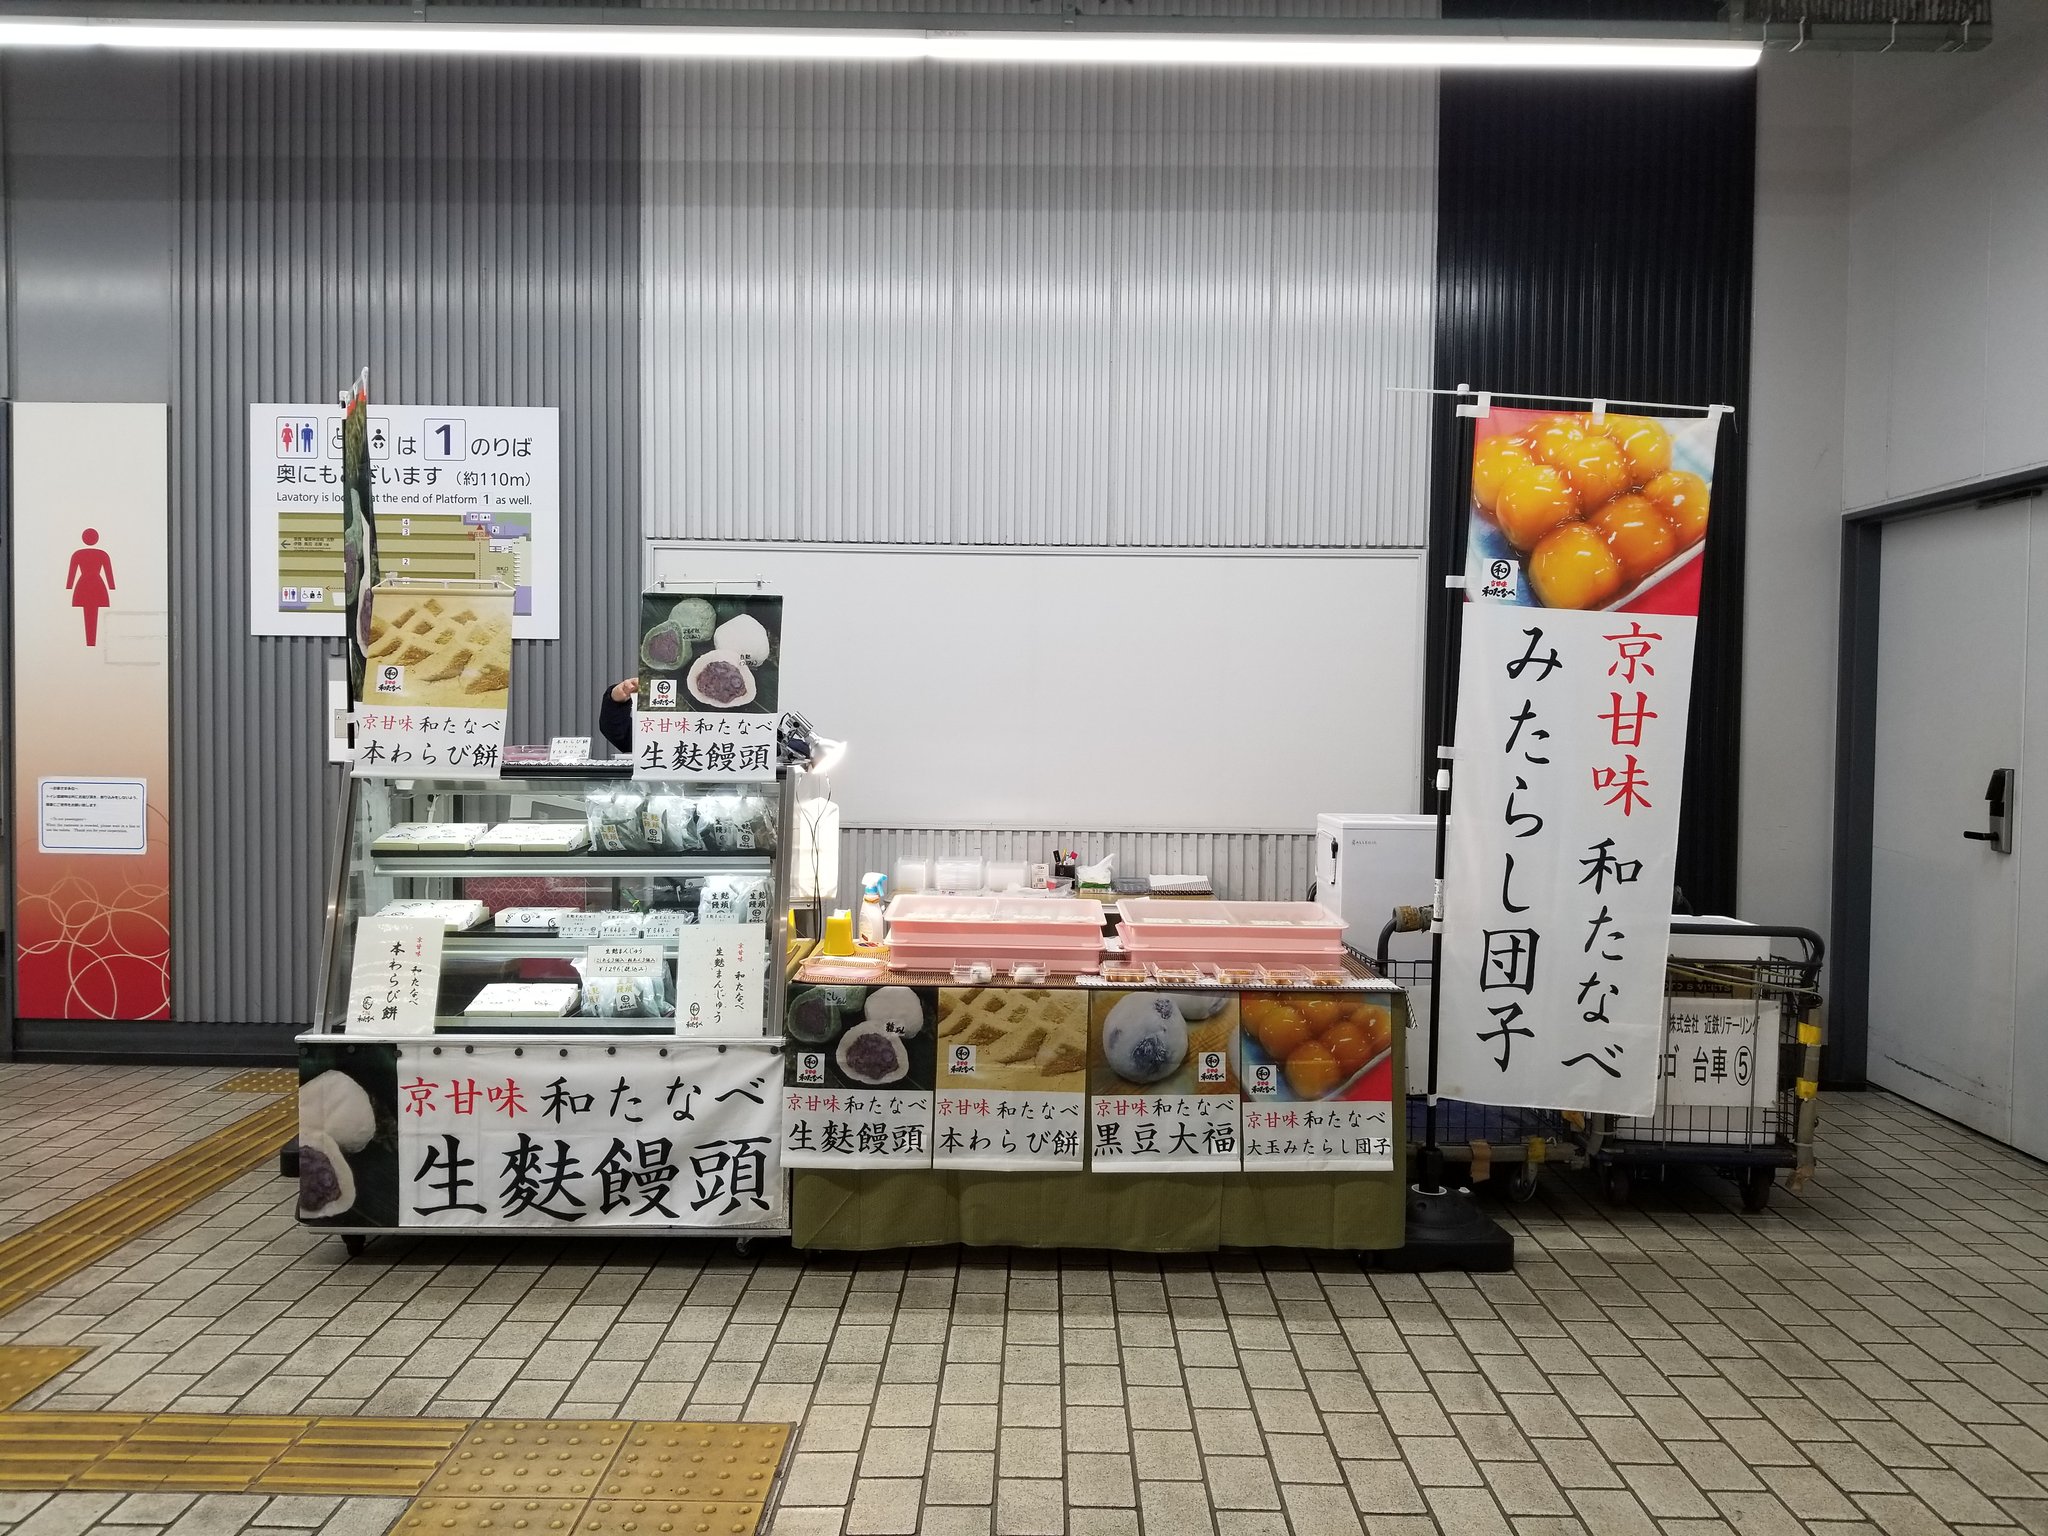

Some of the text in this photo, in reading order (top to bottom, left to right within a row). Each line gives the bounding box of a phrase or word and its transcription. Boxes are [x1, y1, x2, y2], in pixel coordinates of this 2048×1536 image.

[398, 424, 533, 458] は 1 のりば
[276, 464, 443, 485] 奥にもざいます
[276, 492, 319, 504] Lavatory
[321, 492, 329, 502] is
[383, 493, 398, 503] the
[401, 493, 420, 504] end
[422, 493, 433, 504] of
[435, 494, 478, 505] Platform
[482, 494, 489, 504] 1
[495, 496, 507, 505] as
[509, 495, 532, 505] well.
[1481, 586, 1516, 598] 和たなべ
[362, 714, 501, 734] 京甘味 和たなべ
[640, 717, 773, 735] 京甘味 和たなべ
[360, 739, 499, 768] 本わらび餅
[640, 740, 771, 772] 生麩饅頭
[1475, 625, 1564, 1074] みたらし団子
[1560, 621, 1664, 1081] 京甘味 和たなべ
[381, 941, 406, 1021] 本わらび餅
[408, 965, 423, 1006] 和たなべ
[713, 946, 725, 1023] 生麩まんじゅう
[734, 971, 746, 1010] 和たなべ
[1669, 1014, 1700, 1034] 株式会社
[798, 1073, 823, 1082] 和たなべ
[950, 1065, 975, 1074] 和たなべ
[1200, 1072, 1225, 1082] 和たなべ
[400, 1075, 766, 1125] 京甘味 和たなべ
[1251, 1086, 1276, 1094] 和たなべ
[786, 1093, 928, 1115] 京甘味 和たなべ
[937, 1098, 1080, 1121] 京甘味 和たなべ
[1095, 1098, 1235, 1118] 京甘味 和たなべ
[1246, 1110, 1387, 1129] 京甘味 和たなべ
[788, 1119, 926, 1156] 生麩饅頭
[938, 1127, 1080, 1158] 本わらび餅
[1093, 1121, 1237, 1157] 黒豆大福
[1245, 1137, 1391, 1157] 大玉みたらし団子
[412, 1132, 773, 1223] 生麩饅頭
